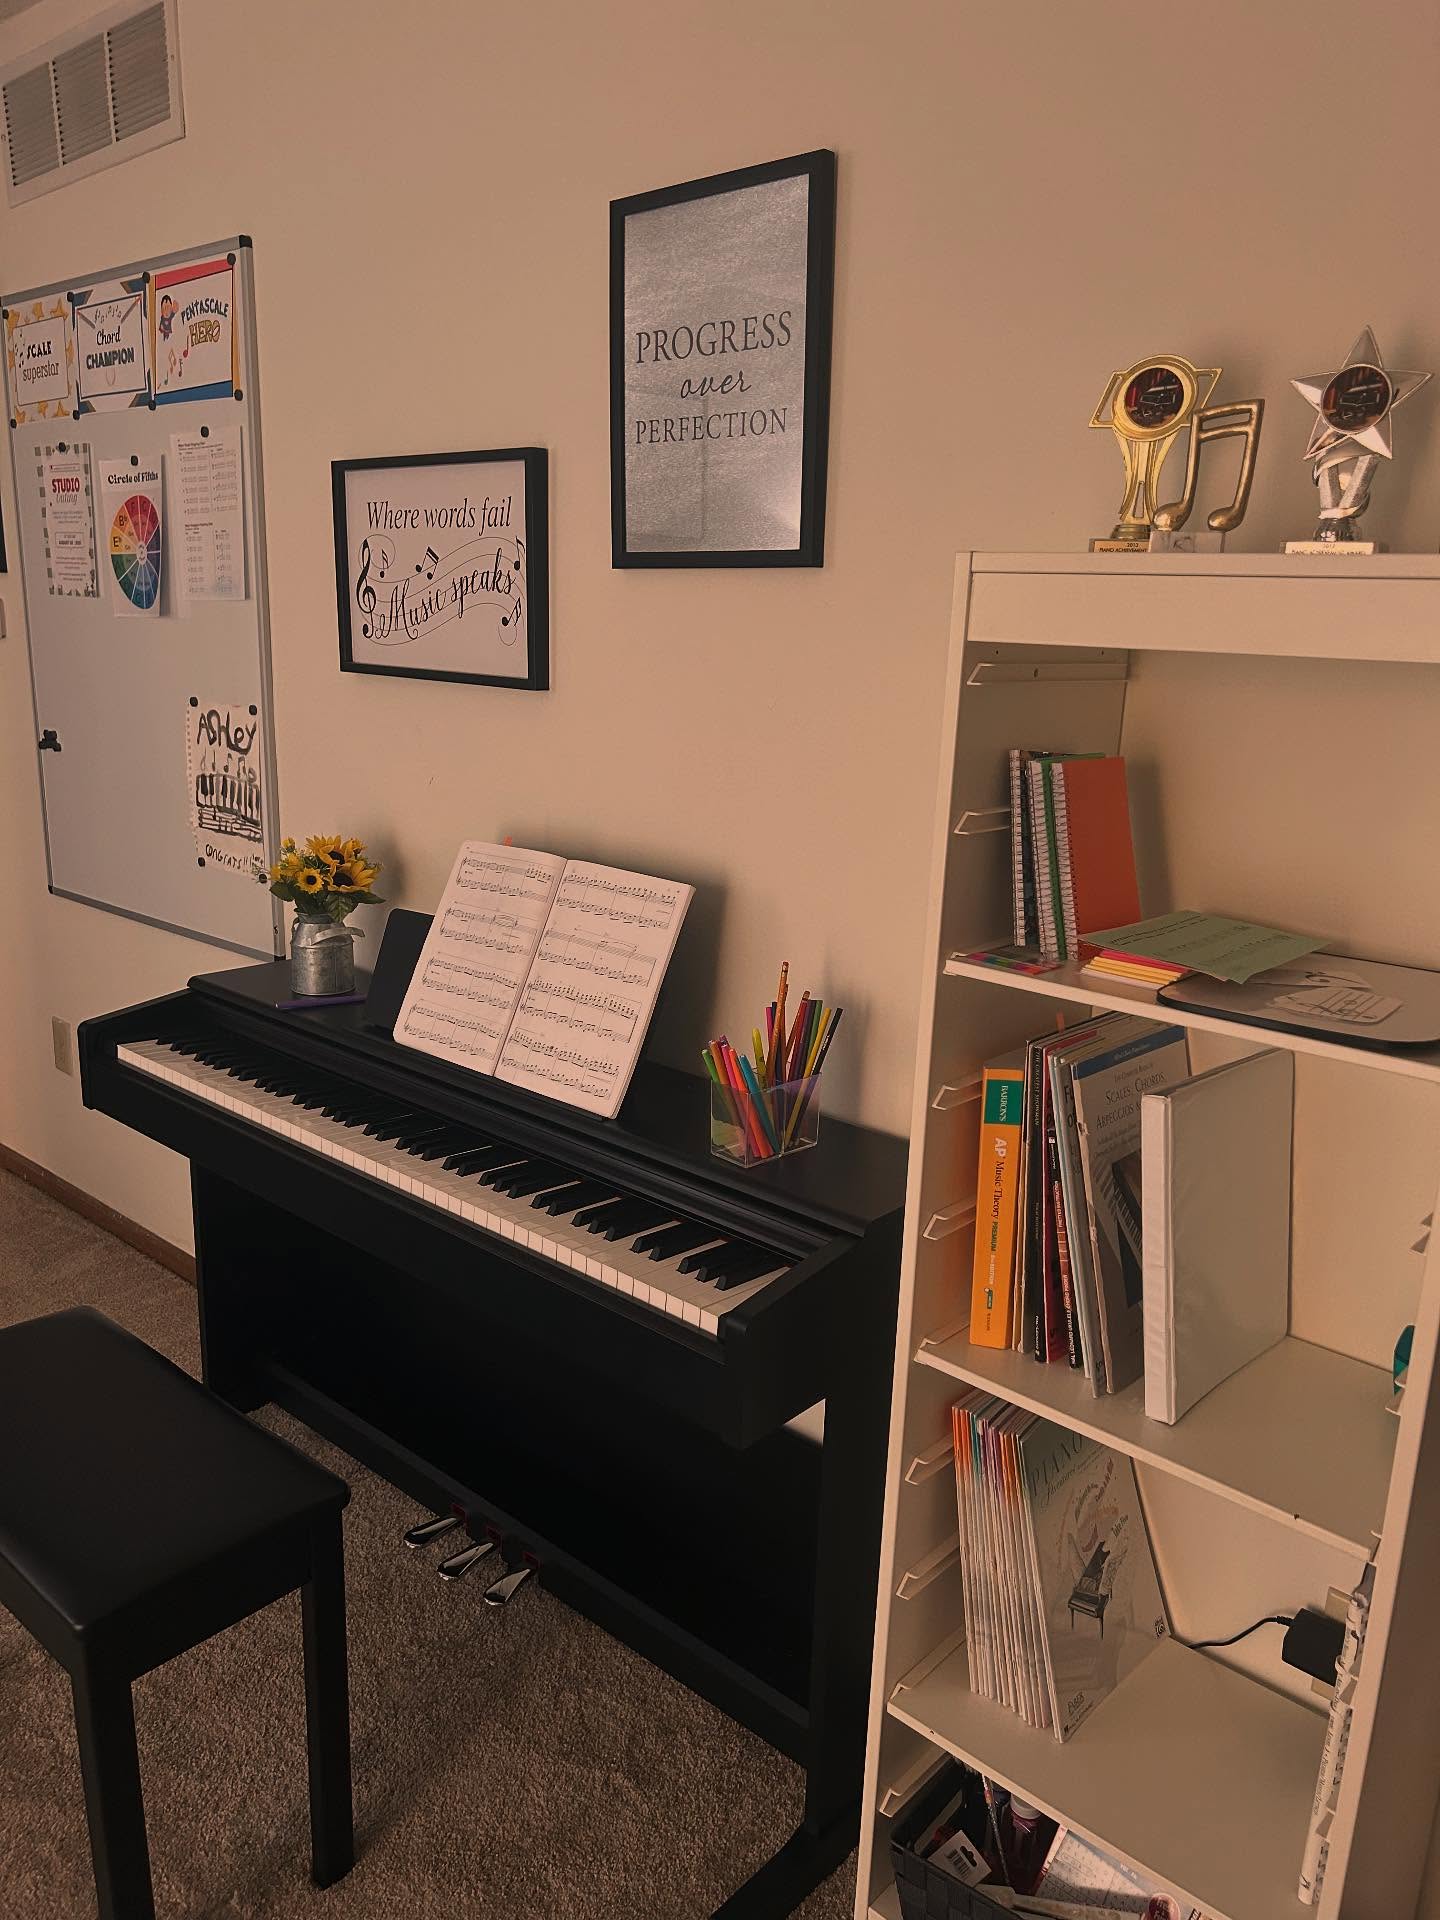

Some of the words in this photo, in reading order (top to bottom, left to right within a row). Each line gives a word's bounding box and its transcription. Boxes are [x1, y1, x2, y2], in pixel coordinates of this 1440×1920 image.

[181, 298, 229, 324] PENTASCALE
[96, 325, 121, 346] Chord
[188, 319, 221, 348] HERO
[636, 310, 792, 364] PROGRESS
[26, 340, 52, 359] SCALE
[86, 347, 135, 370] CHAMPION
[22, 360, 60, 384] superstar
[680, 370, 752, 399] over
[636, 408, 788, 444] PERFECTION
[51, 477, 81, 494] STUDIO
[107, 474, 133, 485] Circle
[133, 472, 142, 484] of
[141, 471, 159, 482] Fifths
[367, 501, 420, 530] Where
[424, 498, 476, 529] words
[478, 495, 512, 537] fail
[375, 577, 447, 640] Music
[451, 547, 516, 619] speaks
[999, 1085, 1009, 1122] BARRON'S
[994, 1160, 1005, 1187] Music
[990, 1188, 1003, 1220] Theory
[990, 1221, 999, 1252] PREMIUM
